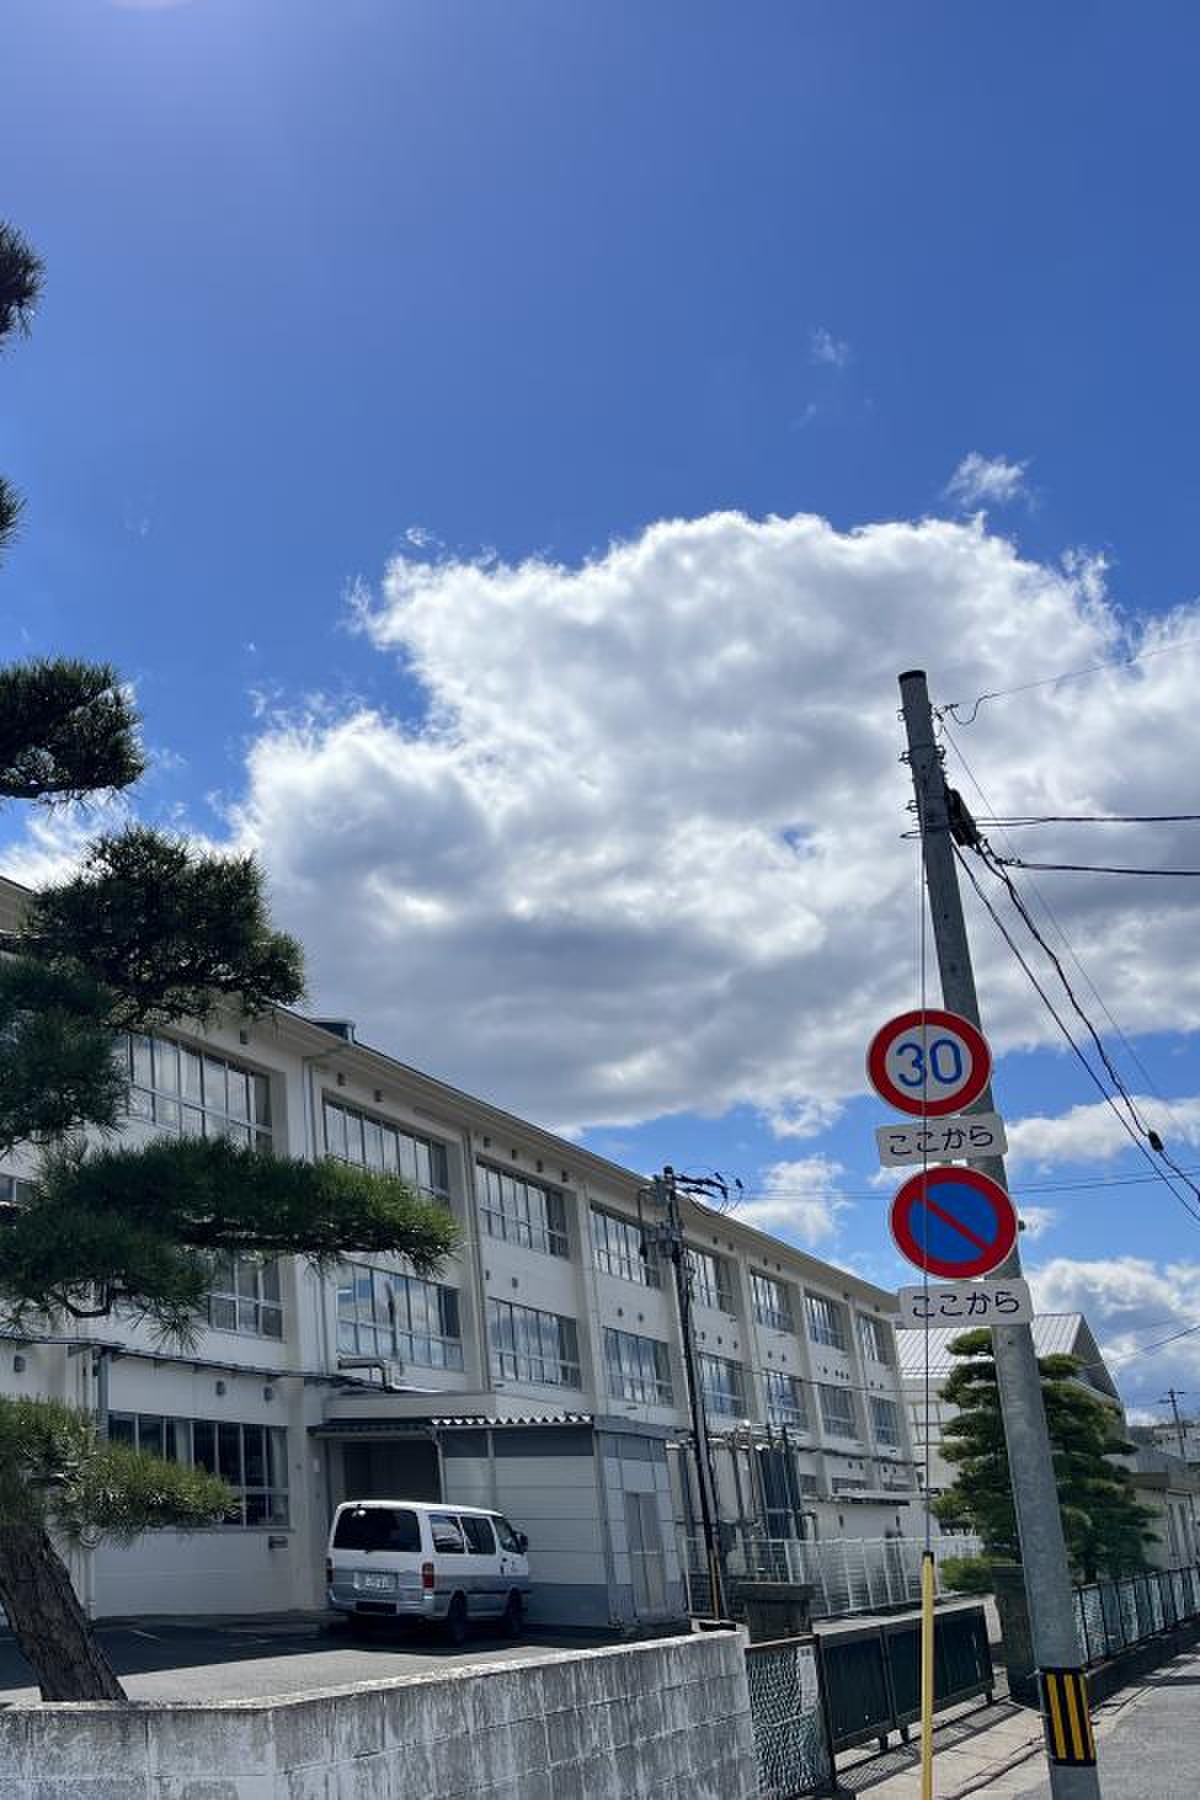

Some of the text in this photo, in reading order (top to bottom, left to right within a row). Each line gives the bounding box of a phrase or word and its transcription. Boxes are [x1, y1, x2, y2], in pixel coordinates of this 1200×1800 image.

[896, 1039, 963, 1087] 30
[889, 1126, 994, 1155] ここから
[912, 1291, 1021, 1319] ここから
